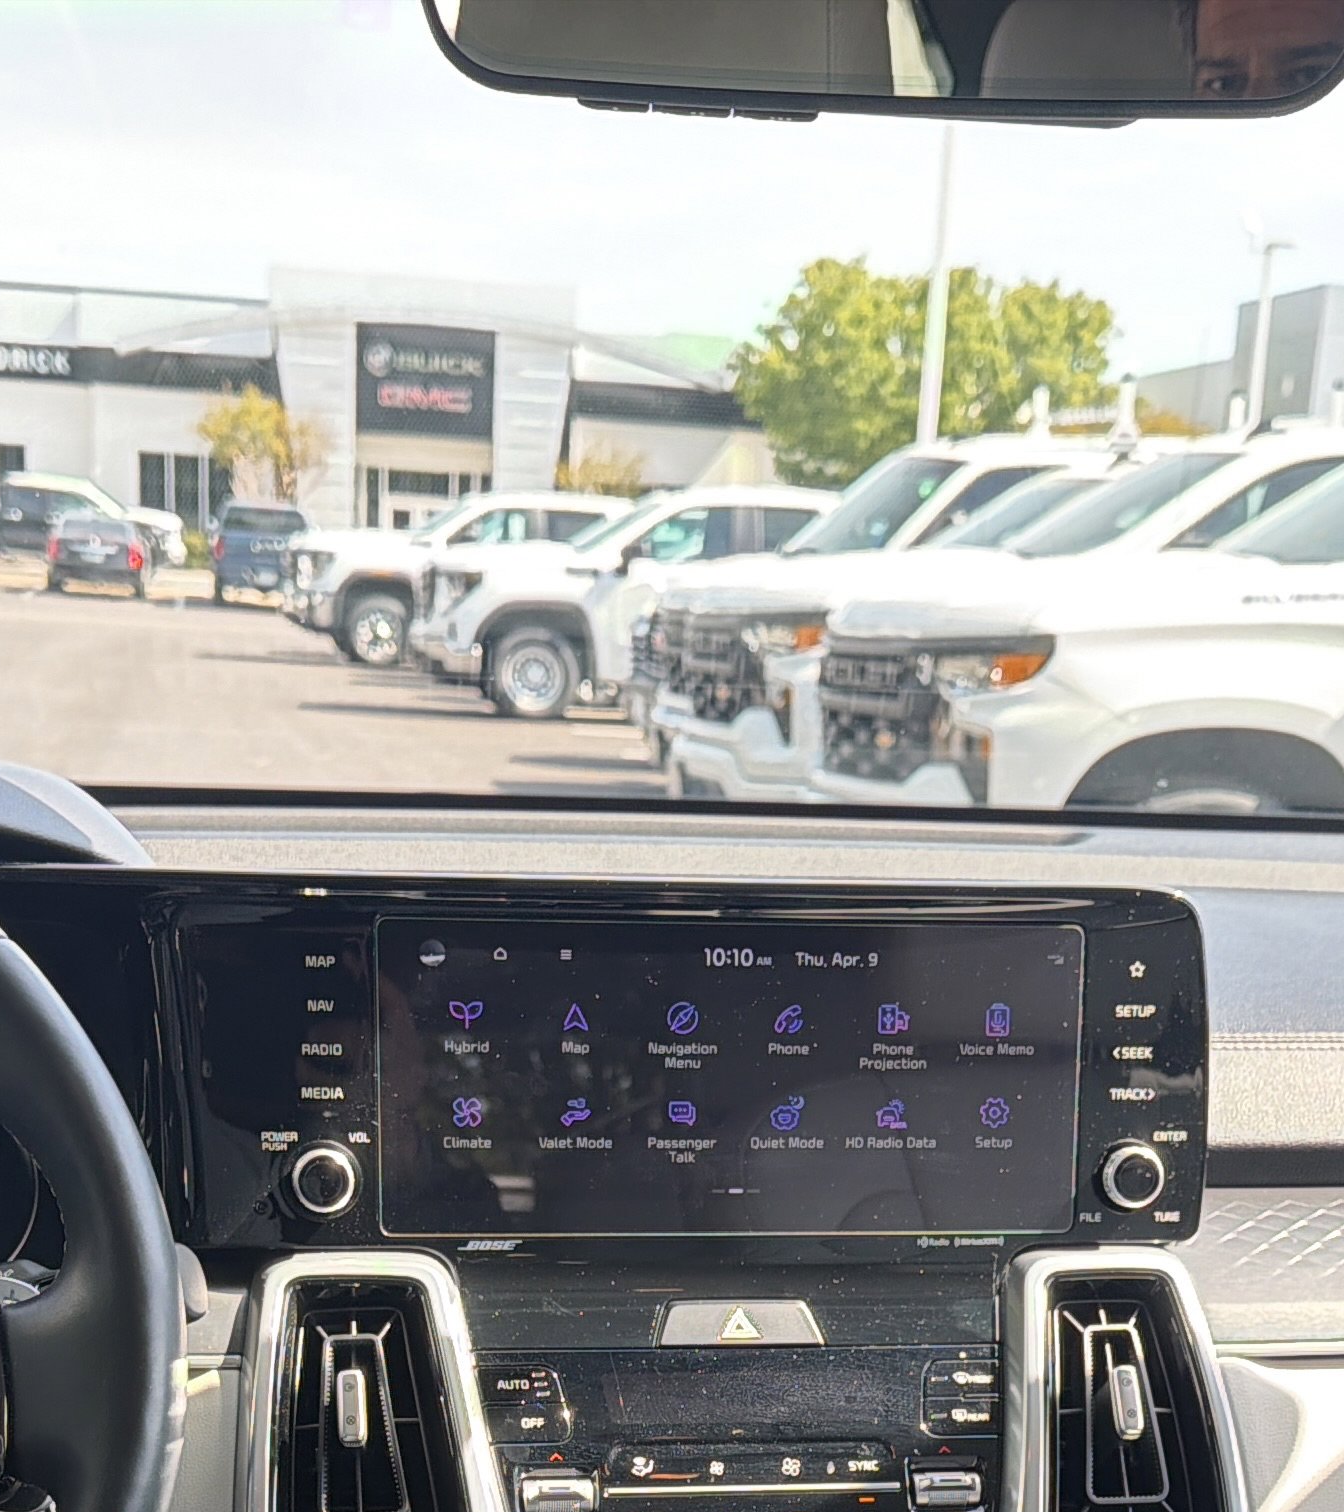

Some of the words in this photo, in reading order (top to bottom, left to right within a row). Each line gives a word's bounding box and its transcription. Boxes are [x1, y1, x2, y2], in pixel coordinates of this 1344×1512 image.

[305, 955, 336, 969] MAP
[704, 947, 754, 967] 10:10
[756, 957, 772, 967] AM
[795, 952, 828, 969] Thu,
[831, 953, 864, 970] Apr.
[868, 953, 878, 967] 9
[307, 1000, 334, 1013] NAV
[1115, 1005, 1156, 1018] SETUP
[301, 1043, 343, 1056] RADIO
[444, 1040, 490, 1056] Hybrid
[561, 1041, 590, 1056] Map
[648, 1042, 718, 1057] Navigation
[768, 1043, 809, 1056] Phone
[873, 1043, 914, 1056] Phone
[959, 1043, 993, 1056] Voice
[996, 1043, 1034, 1056] Memo
[665, 1057, 701, 1069] Menu
[859, 1058, 927, 1072] Projection
[301, 1087, 344, 1100] MEDIA
[1110, 1088, 1147, 1100] TRACK
[261, 1131, 298, 1142] POWER
[348, 1132, 371, 1144] VOL
[1153, 1131, 1188, 1142] ENTER
[262, 1142, 288, 1151] PUSH
[443, 1137, 492, 1150] Climate
[538, 1137, 573, 1150] Valet
[576, 1137, 613, 1150] Mode
[648, 1137, 717, 1153] Passenger
[750, 1137, 785, 1151] Quiet
[788, 1137, 824, 1150] Mode
[845, 1137, 864, 1150] HD
[867, 1137, 903, 1150] Radio
[906, 1137, 937, 1150] Data
[975, 1137, 1013, 1153] Setup
[669, 1151, 696, 1164] Talk
[1079, 1211, 1102, 1222] FILE
[457, 1239, 523, 1251] BOSE
[497, 1379, 530, 1390] AUTO
[521, 1417, 545, 1429] OFF
[848, 1460, 880, 1472] SYNC
